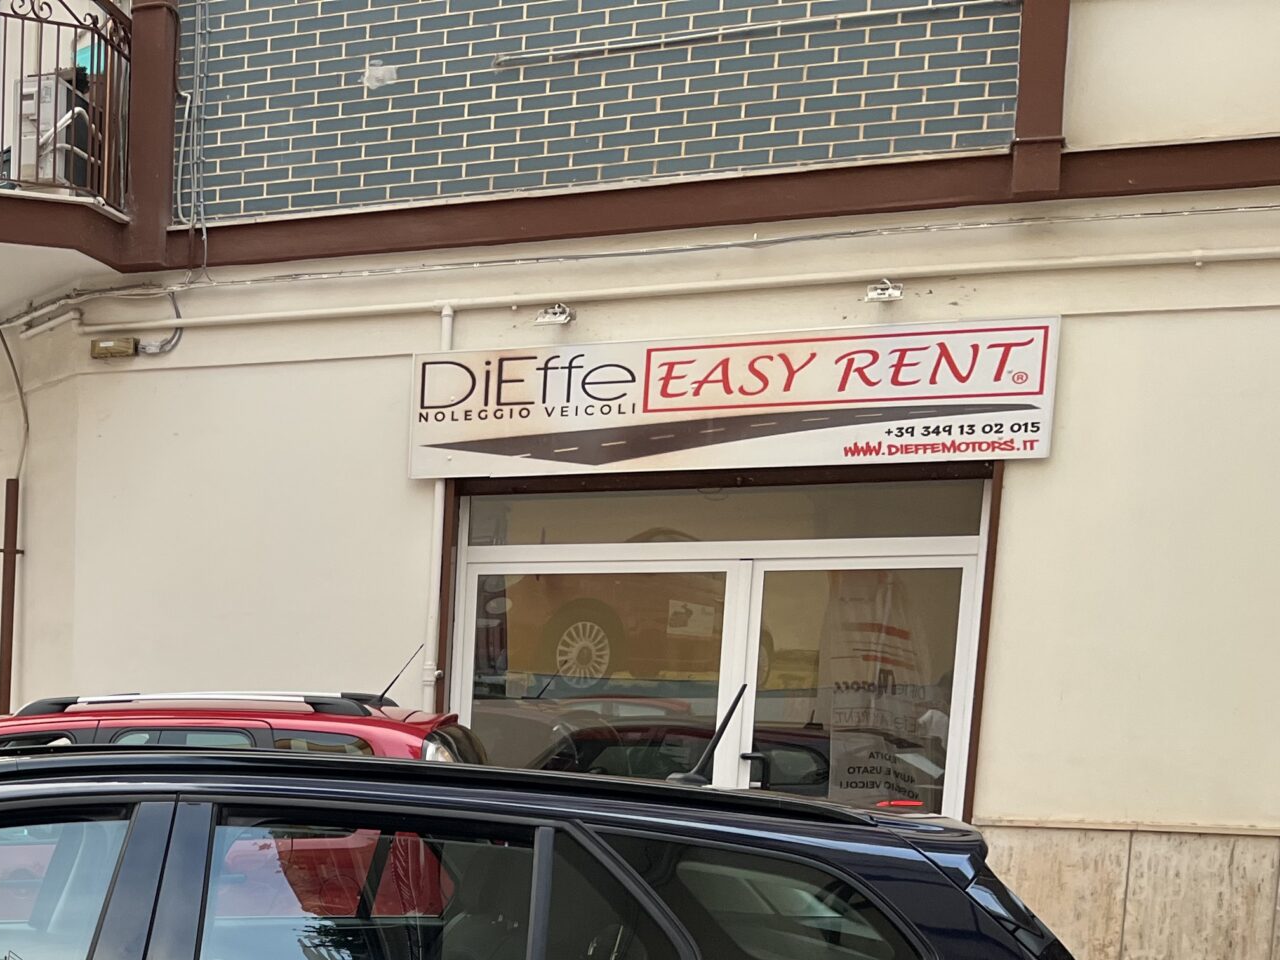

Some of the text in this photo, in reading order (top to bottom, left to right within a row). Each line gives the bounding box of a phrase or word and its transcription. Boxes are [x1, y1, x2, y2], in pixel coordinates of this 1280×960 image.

[657, 351, 818, 398] EASY
[834, 337, 1035, 393] RENT
[420, 354, 637, 409] DiEffe
[419, 402, 637, 423] NOLEGGIO VEICOLI
[884, 422, 1041, 438] +39 349 13 02 015
[843, 438, 1040, 457] WWW.DIEFFEMOTORS.IT
